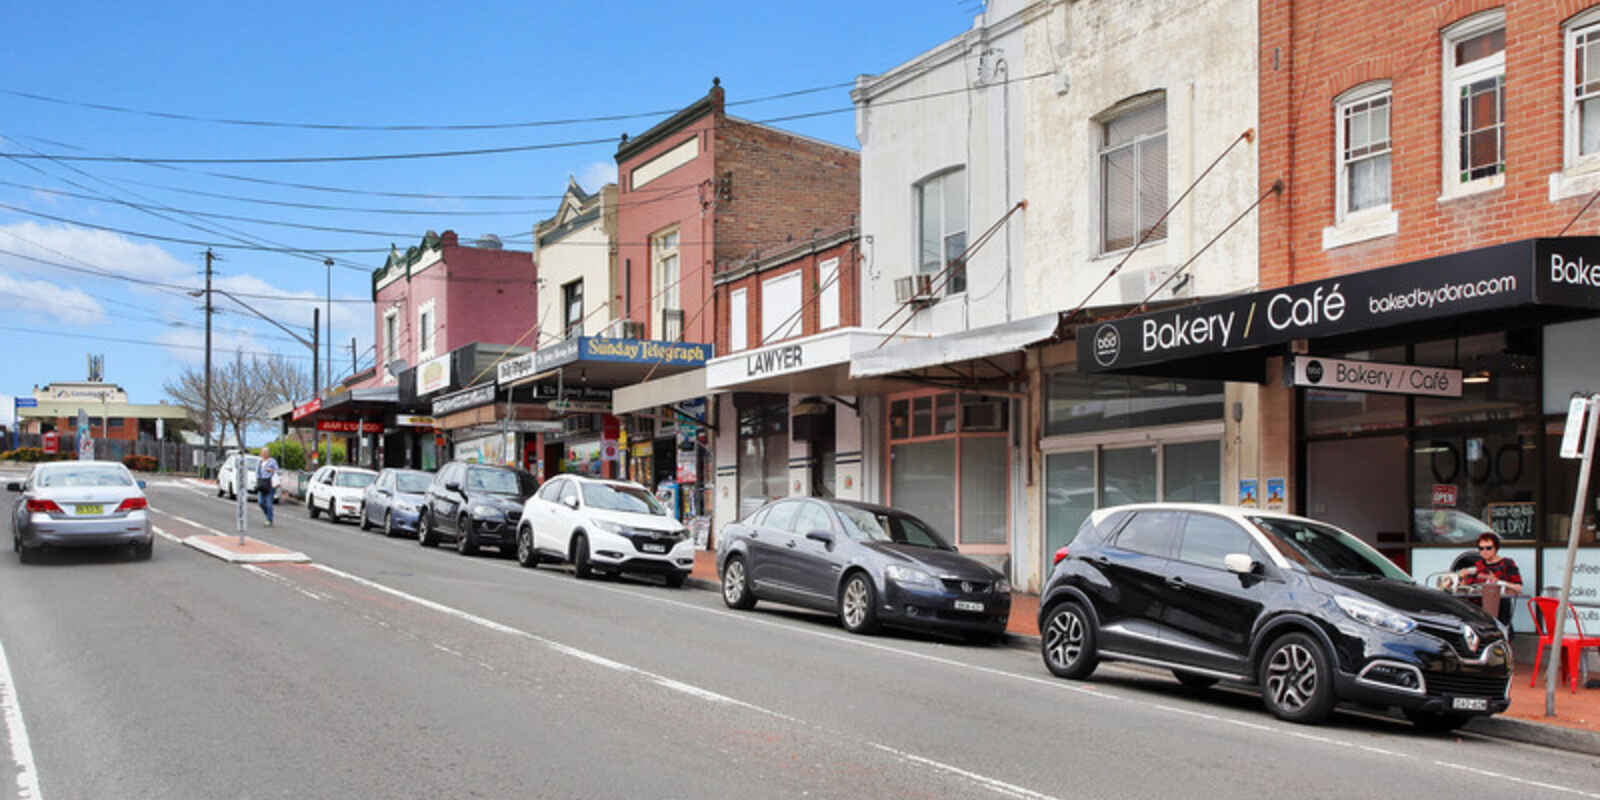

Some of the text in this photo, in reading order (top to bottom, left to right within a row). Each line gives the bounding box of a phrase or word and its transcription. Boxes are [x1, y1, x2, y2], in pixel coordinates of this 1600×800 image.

[1369, 275, 1517, 315] bakedbydora.com
[1142, 311, 1236, 353] Bakery
[1266, 283, 1346, 330] Café
[588, 338, 640, 360] Sunday
[641, 341, 705, 362] Telegraph
[746, 344, 803, 377] LAWYER
[1335, 363, 1394, 388] Bakery
[1409, 369, 1450, 391] Café
